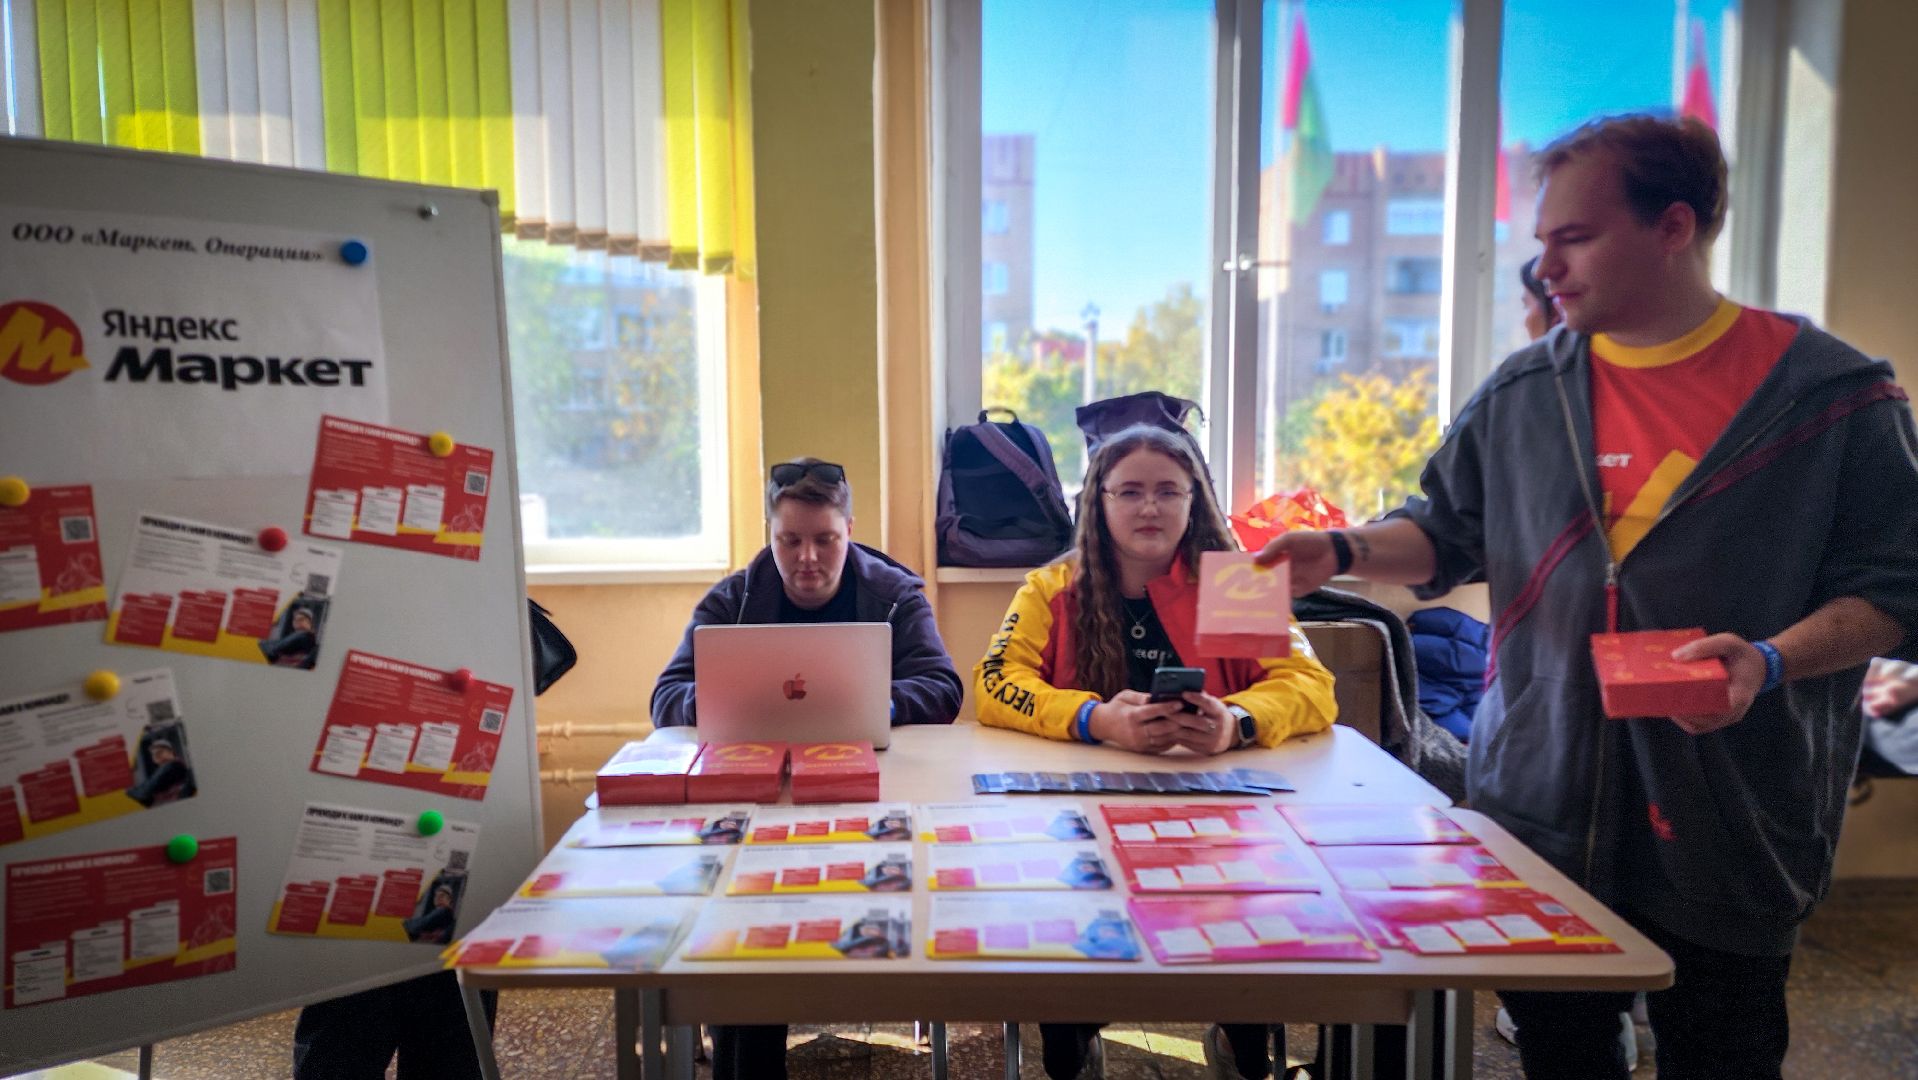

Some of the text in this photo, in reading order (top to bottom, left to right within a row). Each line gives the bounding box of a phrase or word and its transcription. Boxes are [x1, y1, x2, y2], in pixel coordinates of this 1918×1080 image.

[12, 222, 74, 244] ООО
[205, 236, 322, 262] Операции»
[103, 309, 238, 342] Яндекс
[104, 345, 373, 391] Маркет
